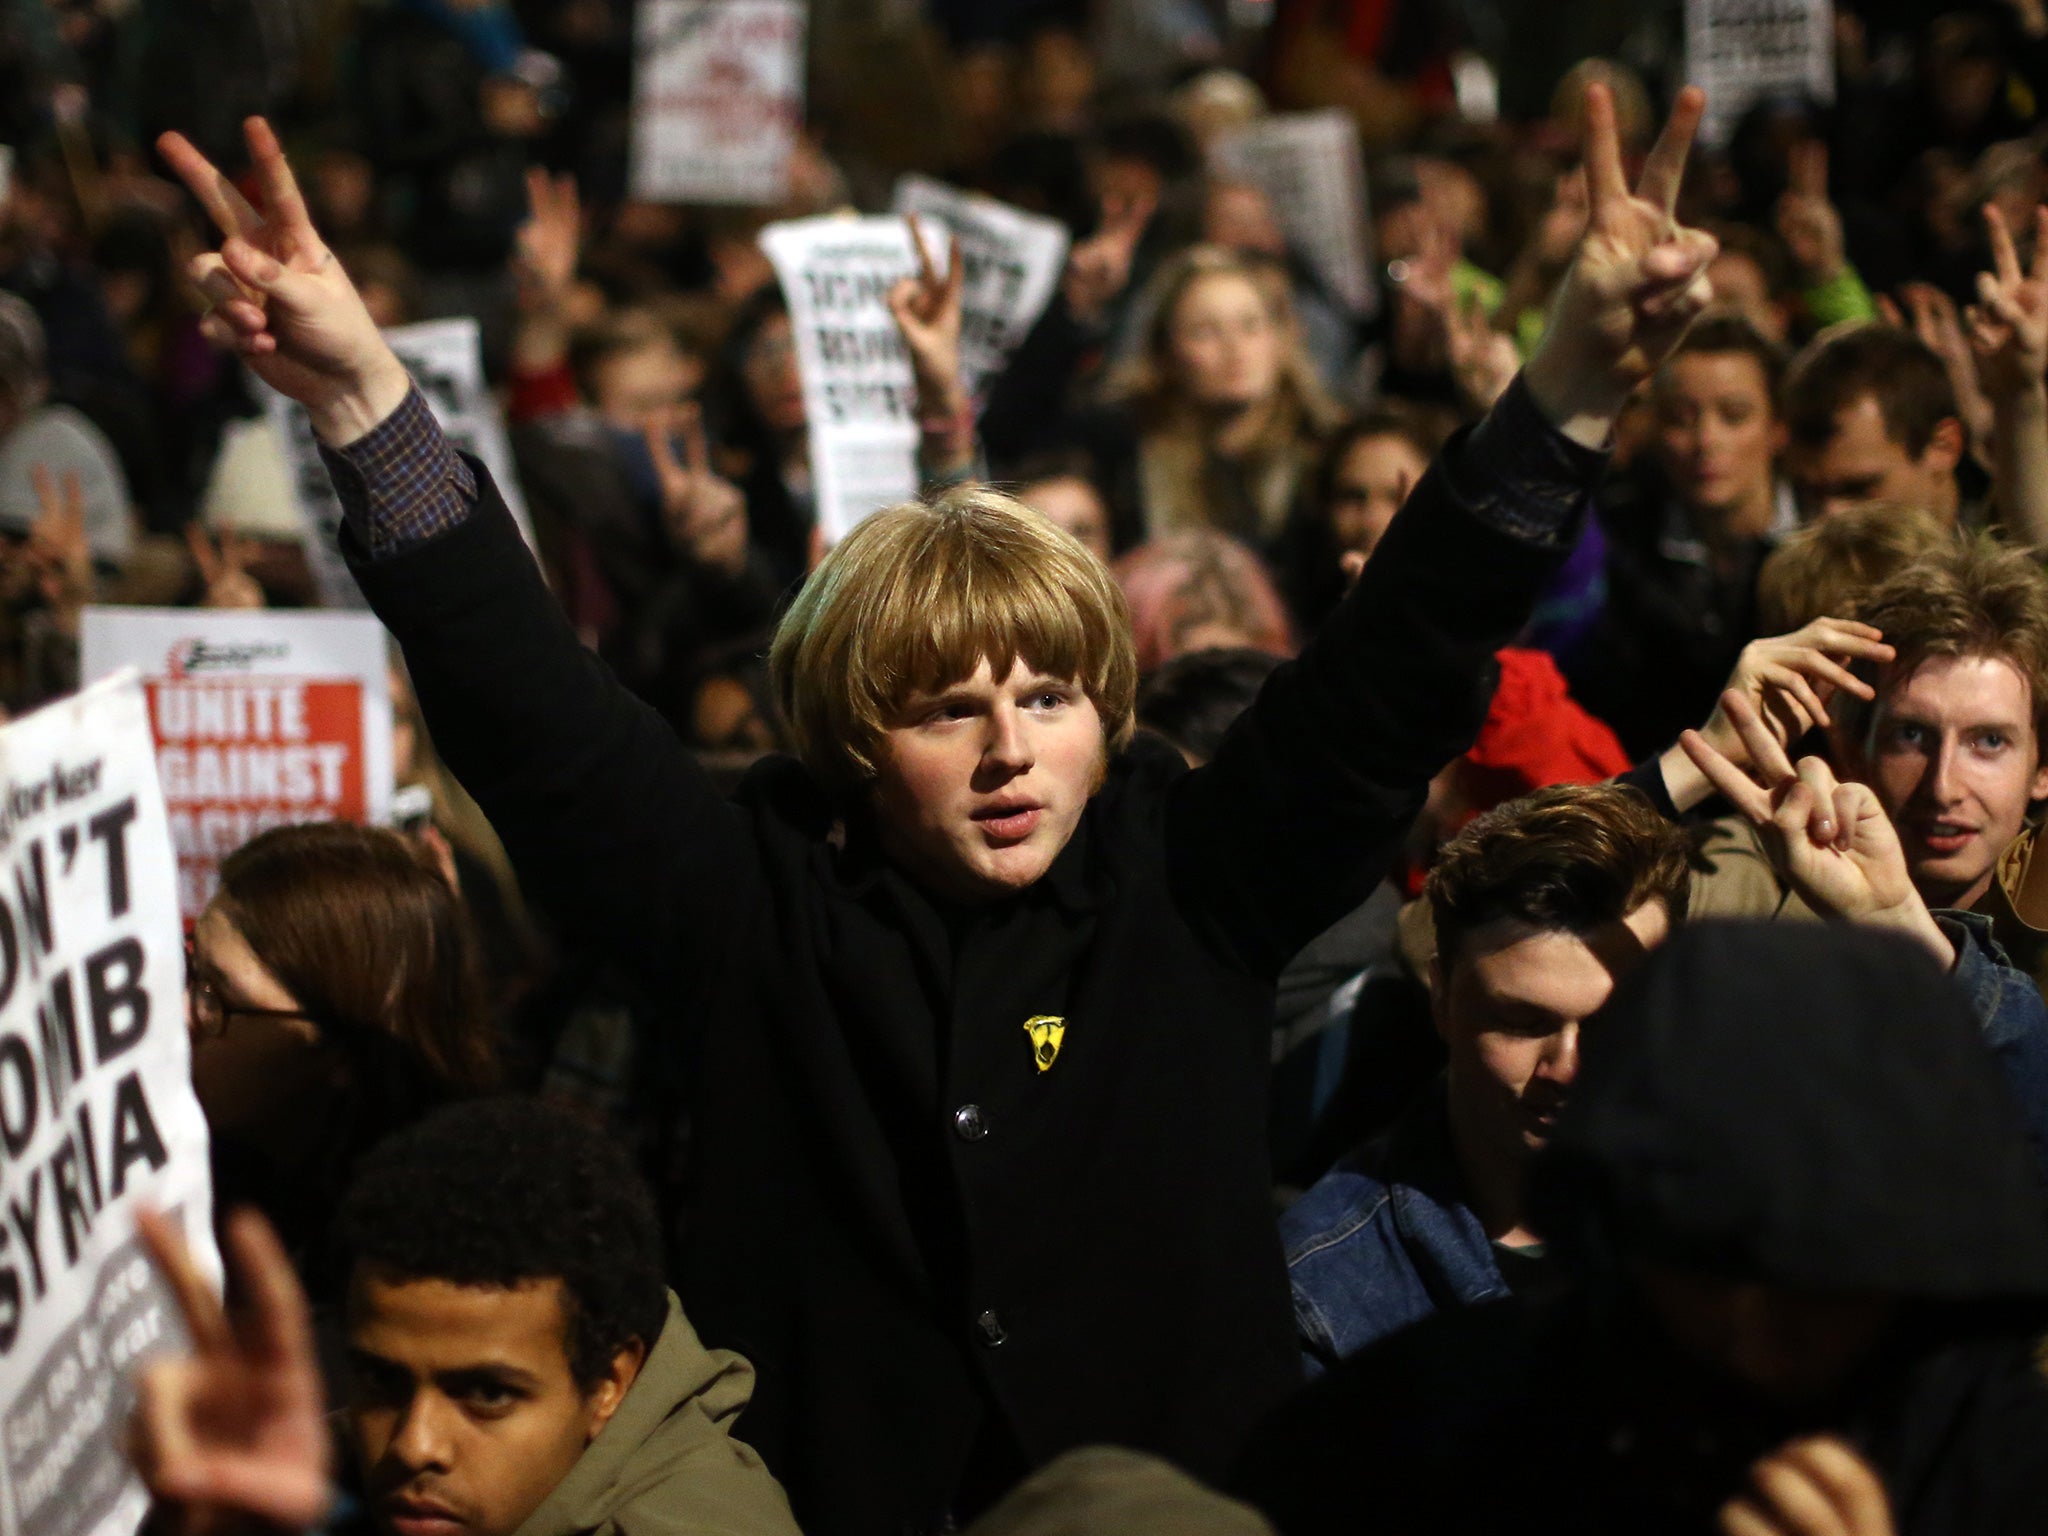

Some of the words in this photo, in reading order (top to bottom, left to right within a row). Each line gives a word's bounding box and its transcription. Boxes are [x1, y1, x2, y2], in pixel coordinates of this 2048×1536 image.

[156, 687, 309, 739] UNITE
[160, 745, 347, 800] GAINST
[0, 936, 151, 1161] OMB
